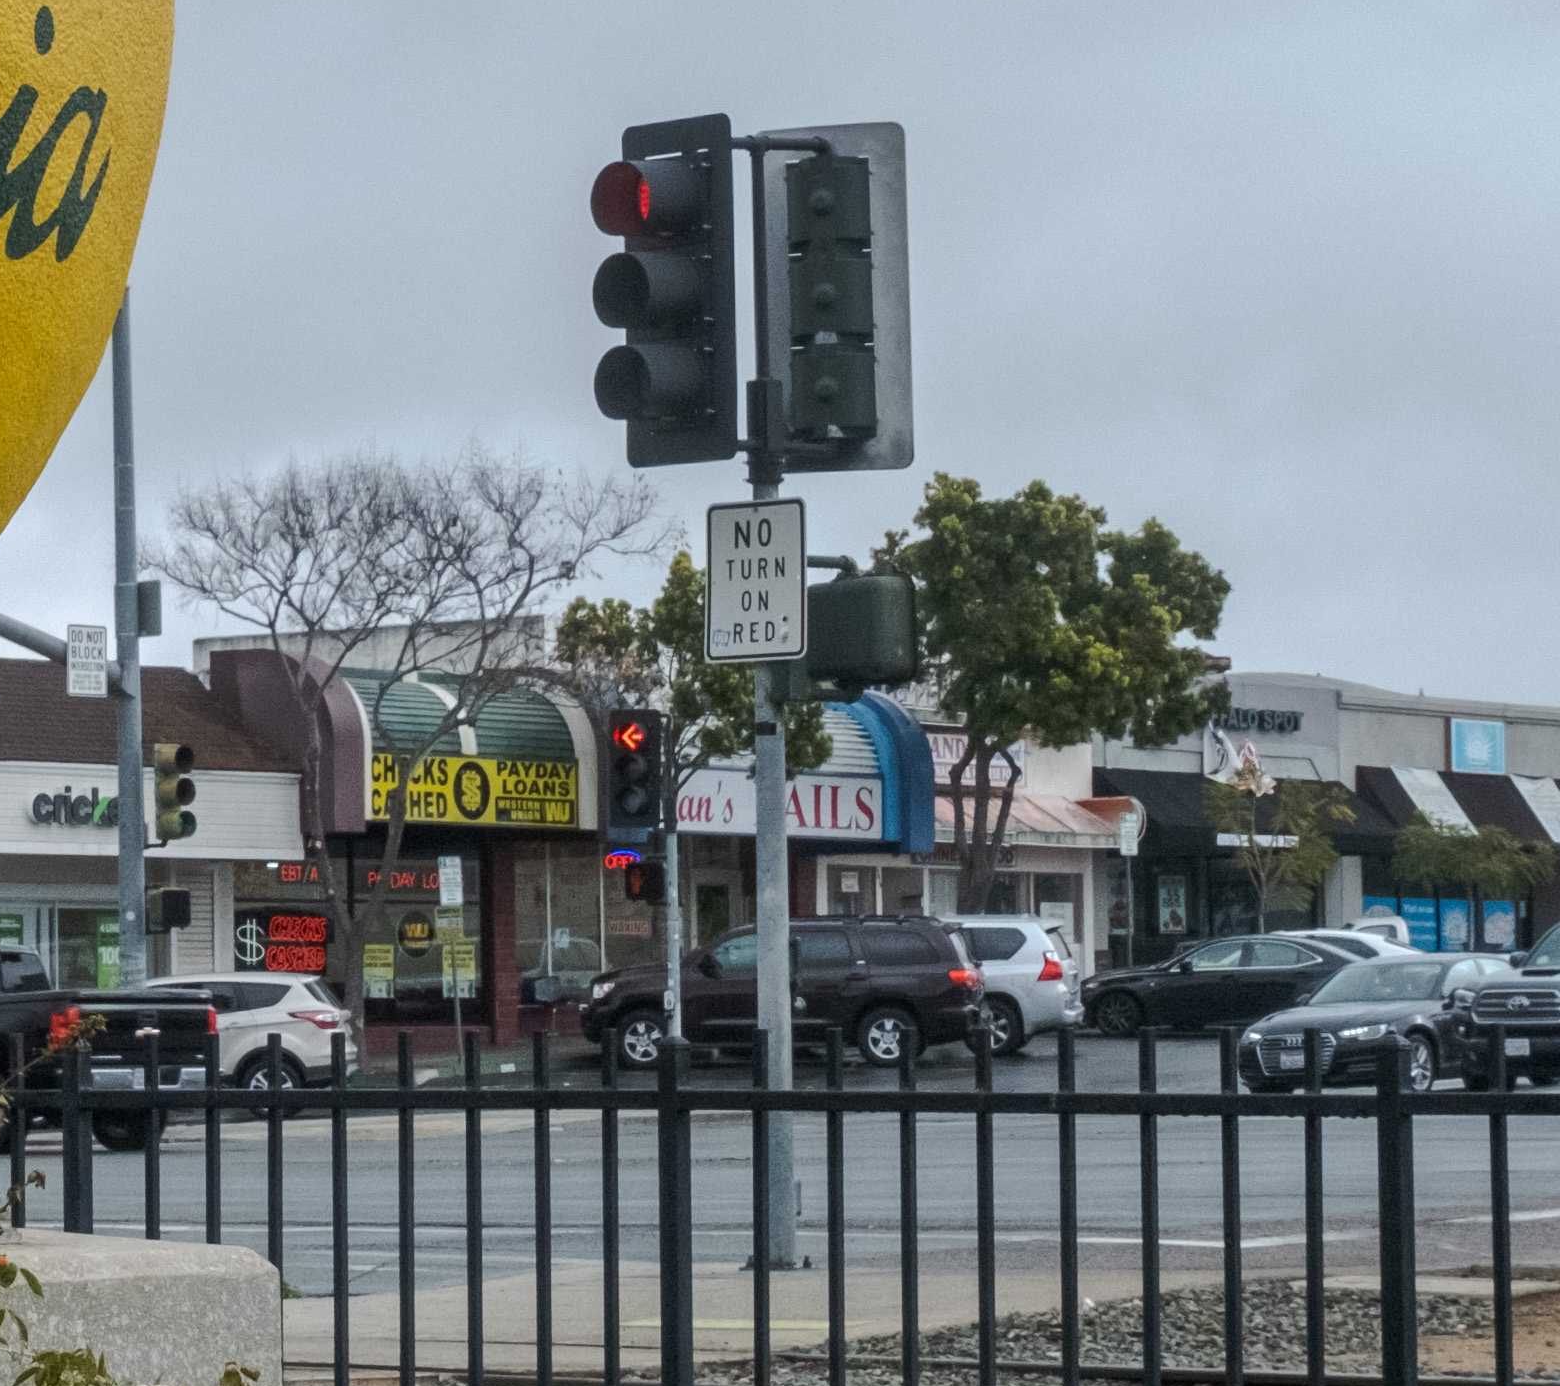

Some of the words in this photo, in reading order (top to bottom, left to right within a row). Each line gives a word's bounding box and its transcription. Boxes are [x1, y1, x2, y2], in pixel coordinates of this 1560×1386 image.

[734, 518, 772, 549] NO
[726, 557, 786, 581] TURN
[741, 590, 769, 612] ON
[71, 629, 84, 644] DO
[86, 630, 104, 644] NOT
[733, 621, 776, 644] RED
[71, 645, 104, 660] BLOCK
[497, 760, 574, 780] PAYDAY
[502, 779, 570, 797] LOANS
[545, 800, 570, 823] WU
[677, 781, 733, 823] an's
[784, 784, 875, 832] AILS
